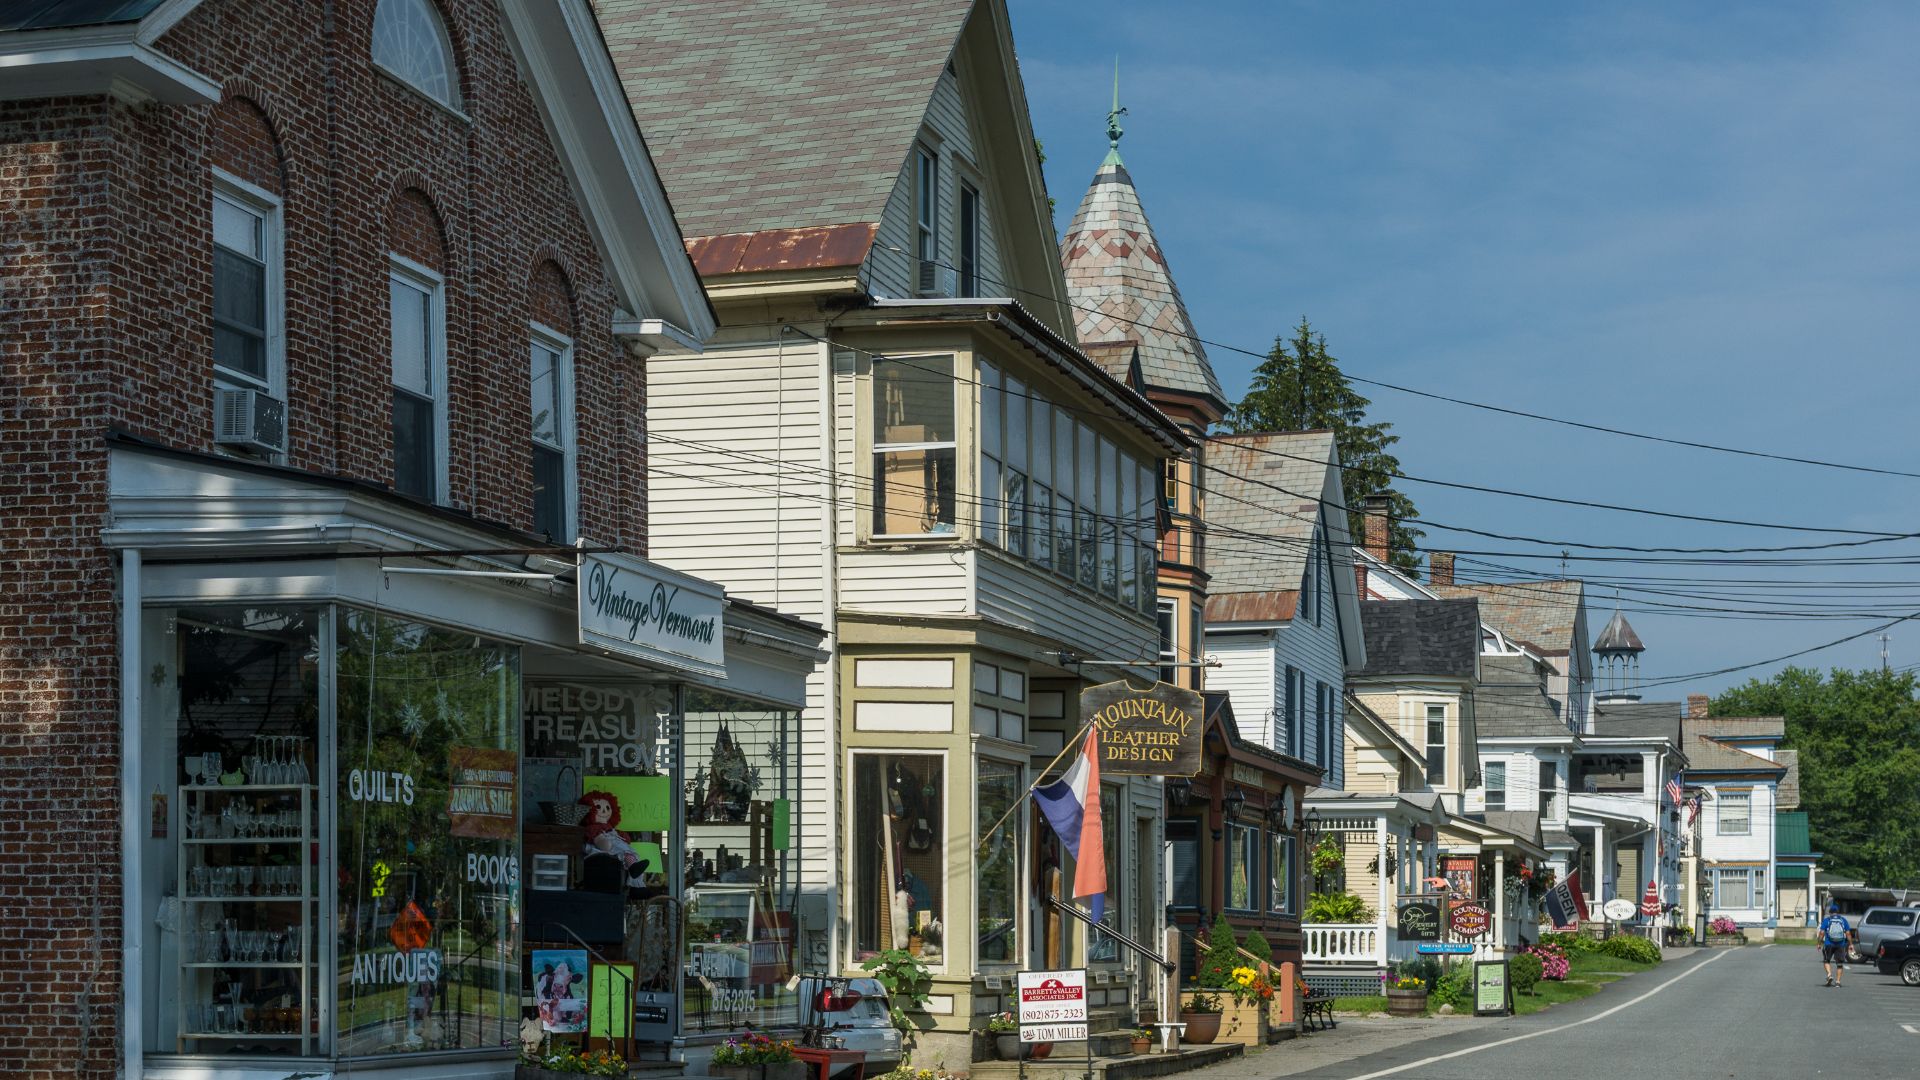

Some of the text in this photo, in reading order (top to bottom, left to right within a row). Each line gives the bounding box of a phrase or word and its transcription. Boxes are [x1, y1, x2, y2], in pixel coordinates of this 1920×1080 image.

[588, 562, 715, 644] Vintage Vermont
[1095, 698, 1193, 738] MOUNTAIN
[1102, 731, 1180, 748] LEATHER
[578, 743, 678, 769] TROVE
[1106, 747, 1174, 762] DESIGN
[349, 767, 415, 806] QUILTS
[466, 852, 520, 885] BOOKS
[1453, 904, 1488, 917] COUNTRY
[1557, 883, 1577, 919] OPEN
[1453, 923, 1487, 936] COMMON
[1455, 916, 1485, 924] ON THE
[350, 950, 440, 985] ANTIQUES
[1028, 992, 1078, 1001] ASSOCIATES INC
[1036, 1027, 1055, 1041] TOM
[1056, 1026, 1087, 1040] MILLER
